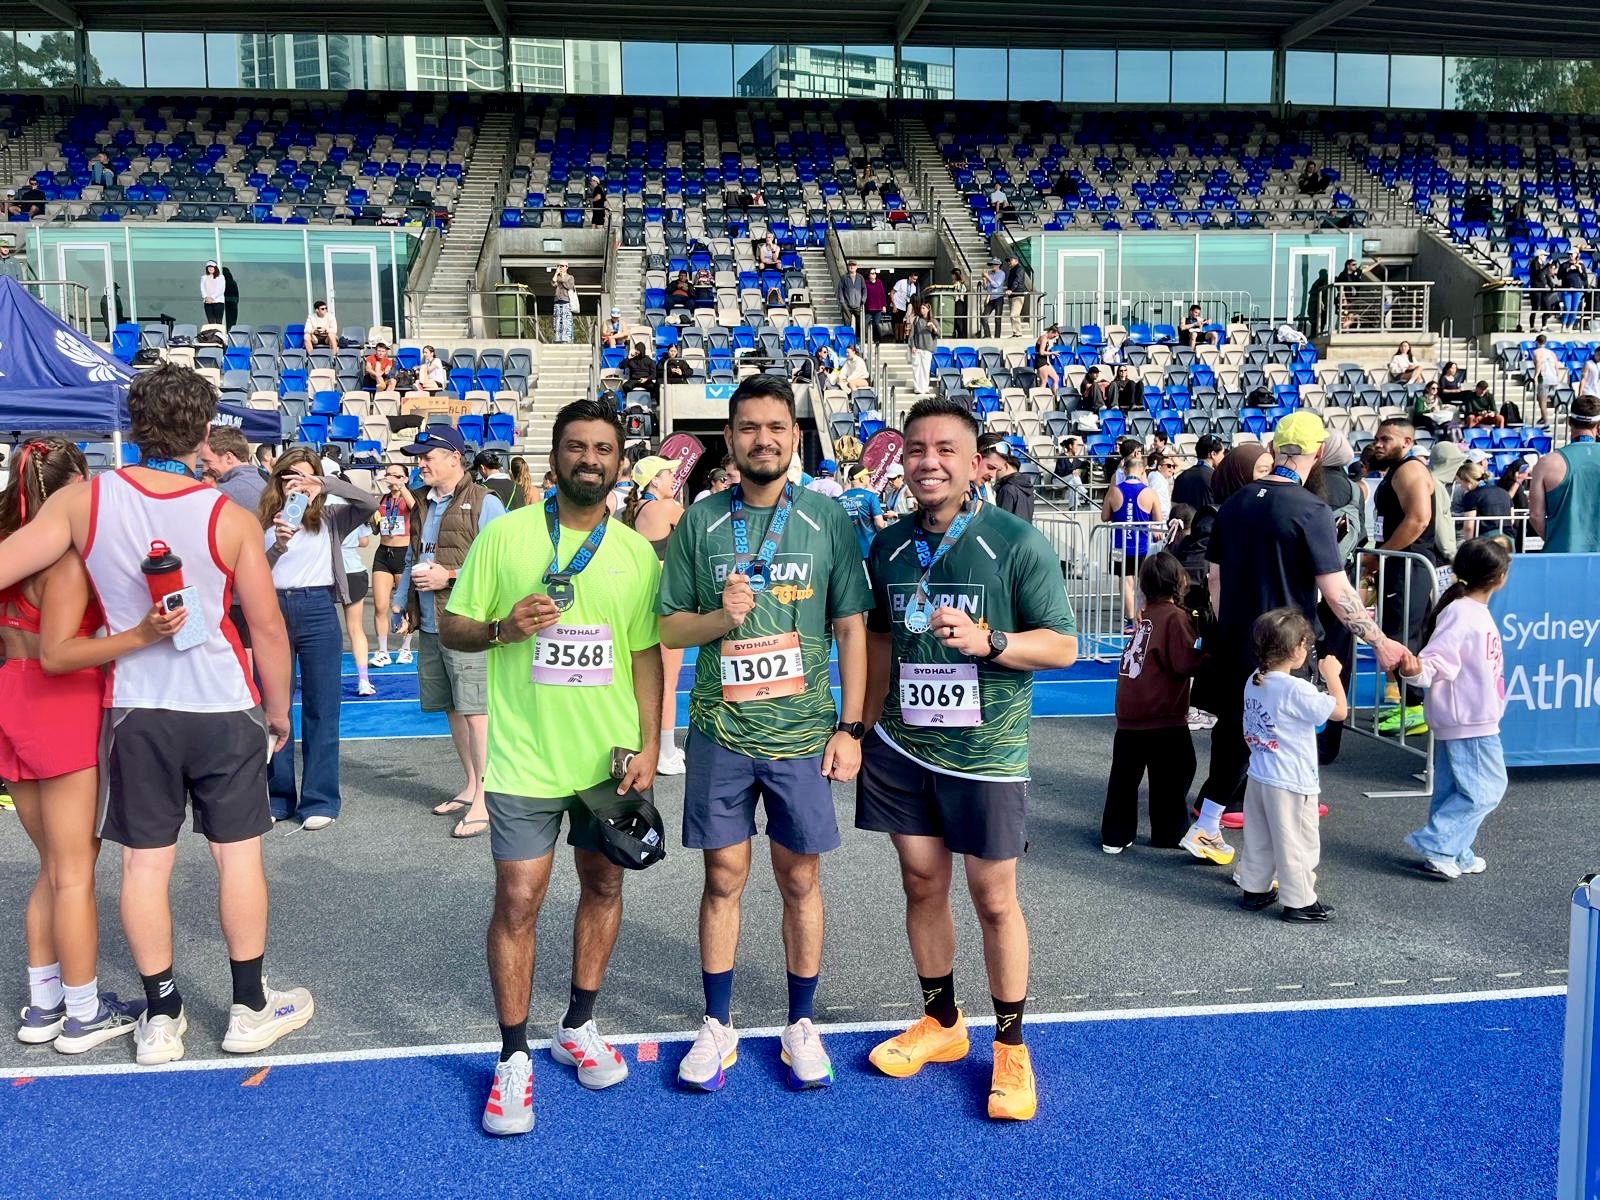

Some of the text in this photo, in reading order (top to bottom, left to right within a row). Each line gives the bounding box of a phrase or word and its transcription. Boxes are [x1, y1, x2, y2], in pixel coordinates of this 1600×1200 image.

[733, 520, 749, 554] 2026
[569, 547, 593, 571] 2026
[1502, 612, 1600, 651] Sydney
[545, 643, 603, 667] 3568
[731, 654, 789, 682] 1302
[908, 684, 965, 707] 3069
